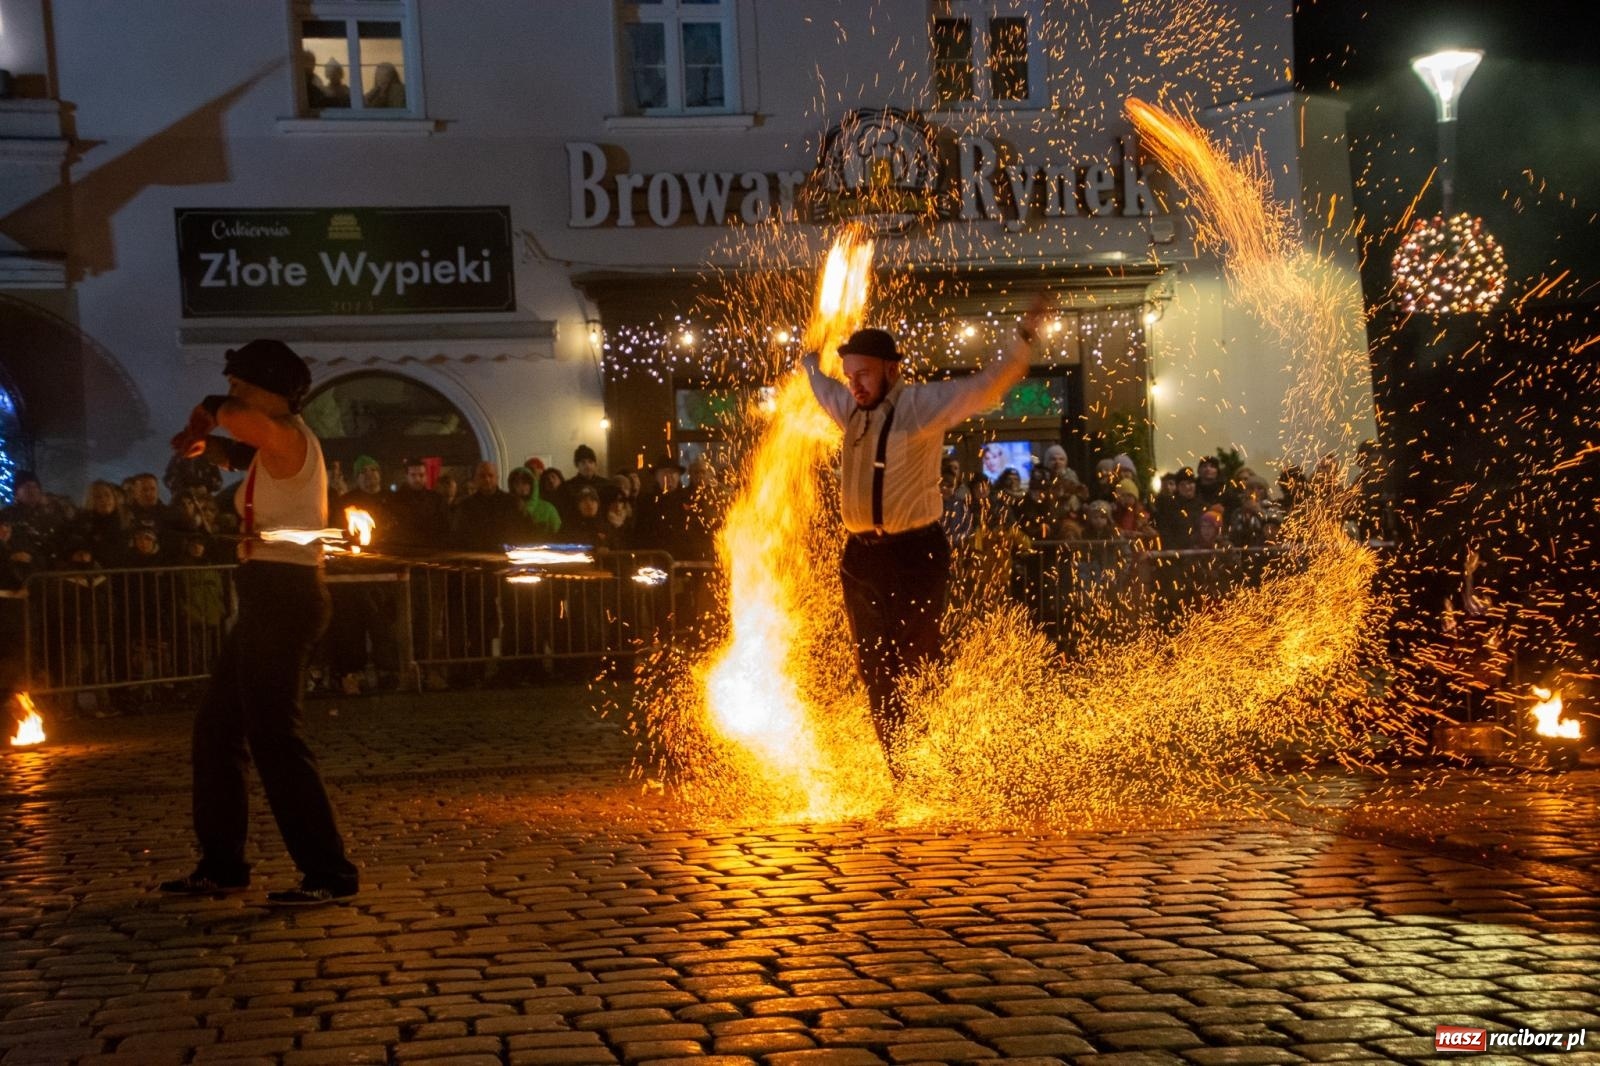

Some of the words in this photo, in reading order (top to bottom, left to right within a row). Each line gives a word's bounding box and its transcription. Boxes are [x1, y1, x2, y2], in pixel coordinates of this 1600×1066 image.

[565, 142, 806, 228] Browar
[959, 136, 1157, 232] Rynek
[211, 218, 291, 240] Cukiernia
[199, 249, 307, 288] Złote
[319, 246, 492, 296] Wypieki
